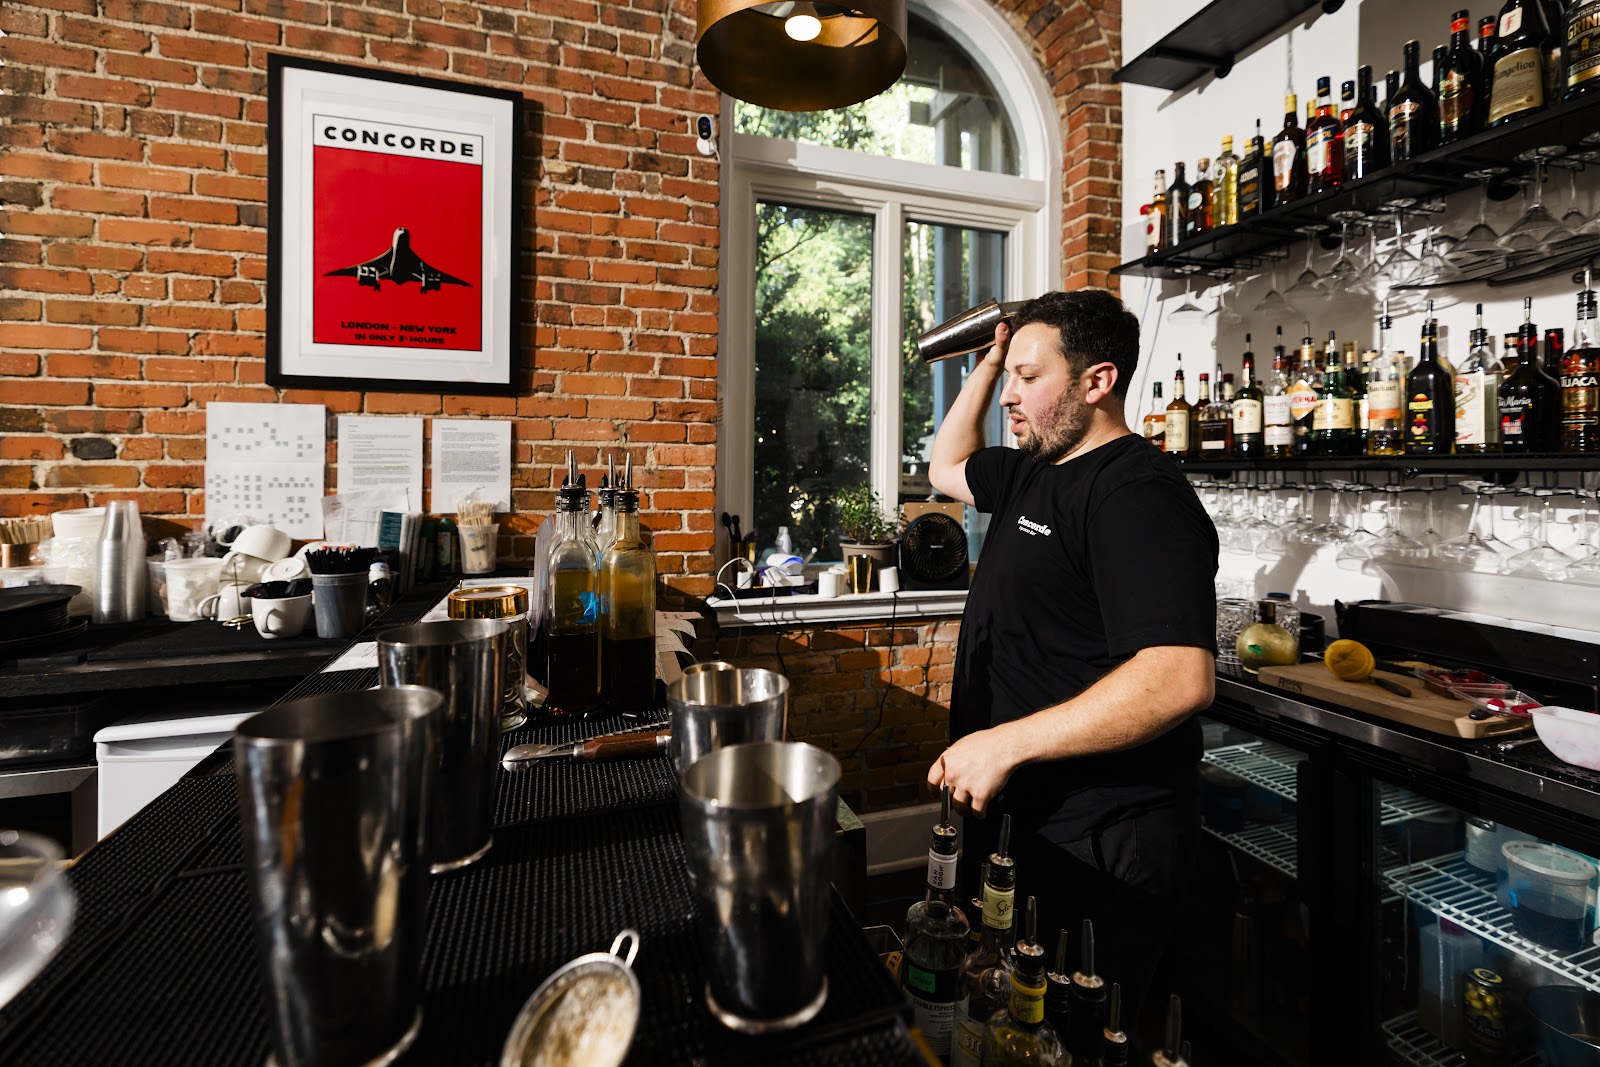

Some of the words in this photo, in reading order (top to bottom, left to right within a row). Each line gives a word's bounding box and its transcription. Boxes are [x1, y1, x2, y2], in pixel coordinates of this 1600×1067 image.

[324, 126, 474, 157] CONCORDE
[341, 321, 389, 331] LONDON
[400, 324, 425, 333] NEW
[428, 325, 457, 334] YORK
[369, 334, 395, 342] ONLY
[409, 336, 445, 344] HOURS
[1560, 376, 1598, 388] TUACA
[1018, 515, 1051, 536] Concorde
